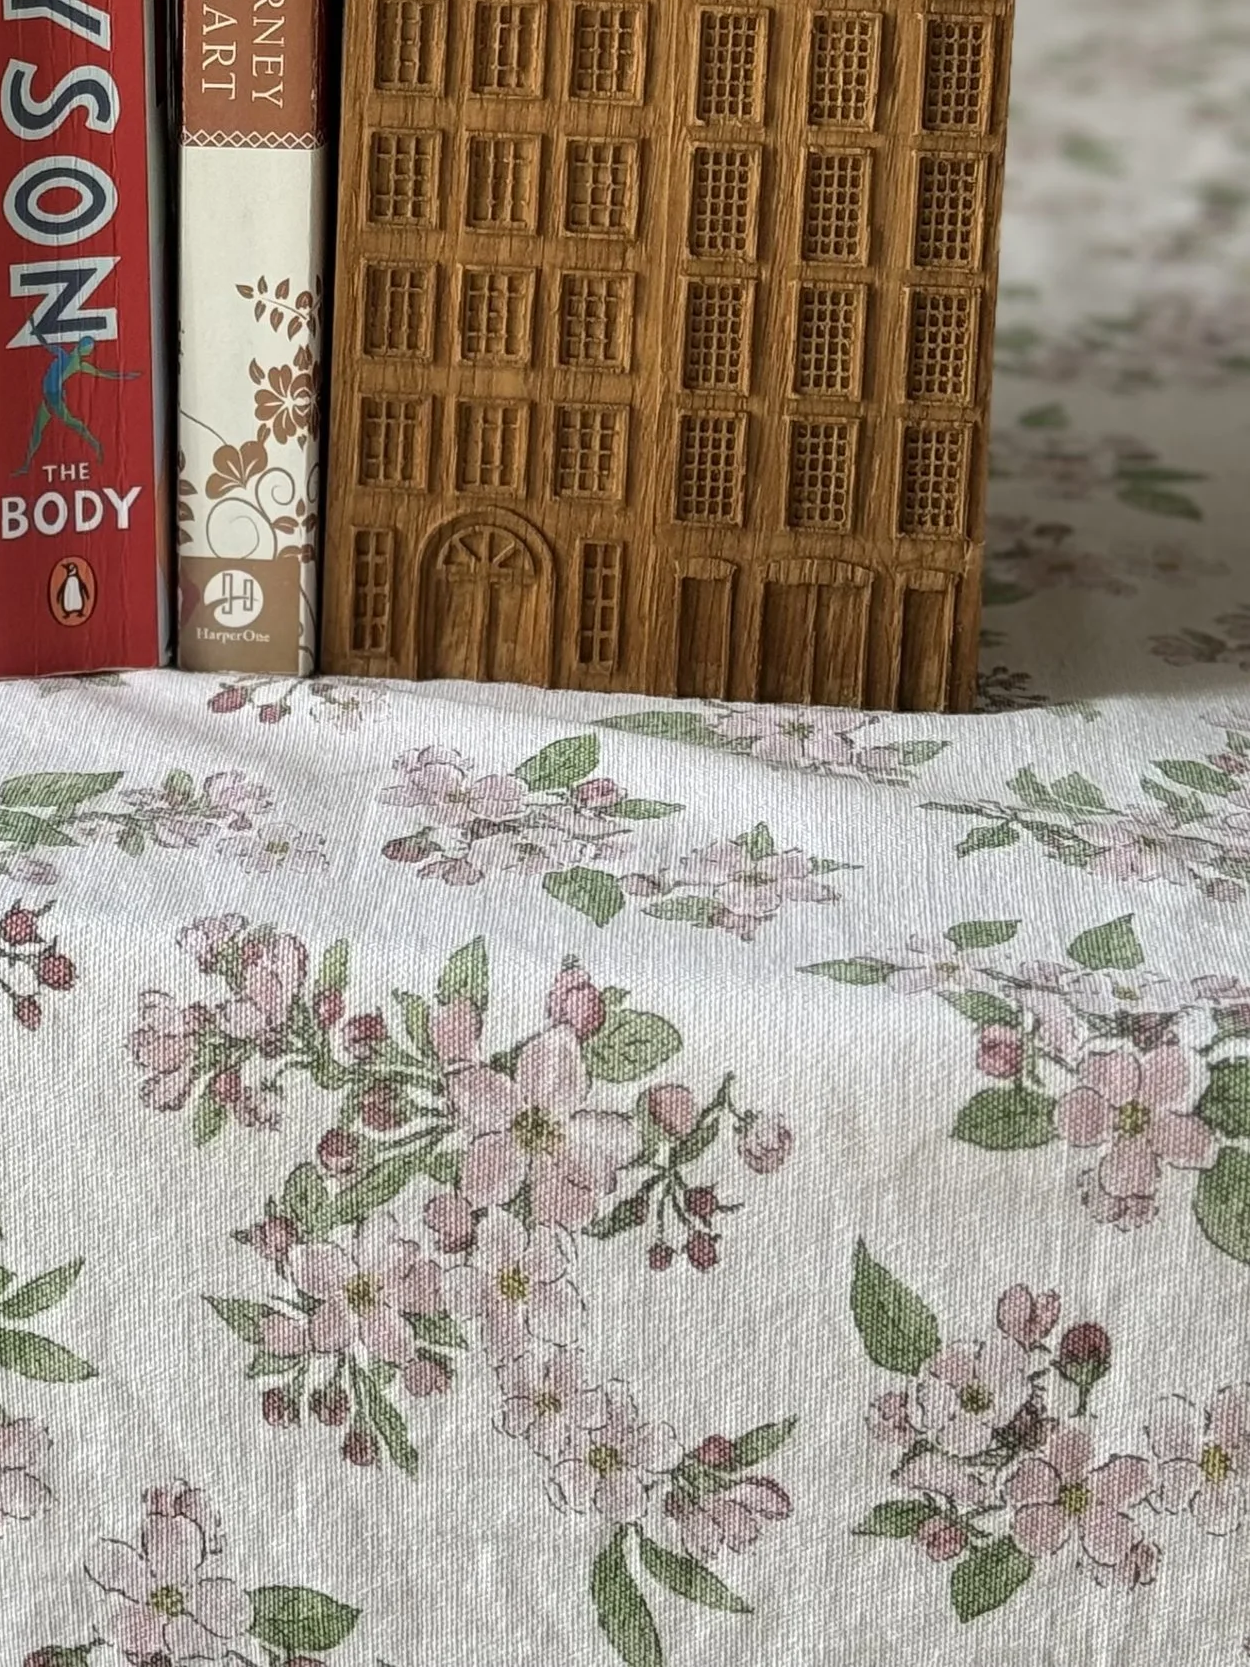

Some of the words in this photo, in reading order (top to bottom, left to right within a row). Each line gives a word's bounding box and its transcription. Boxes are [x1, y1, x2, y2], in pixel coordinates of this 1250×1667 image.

[42, 462, 90, 483] THE
[1, 486, 143, 540] BODY
[196, 627, 270, 644] HarperOne
